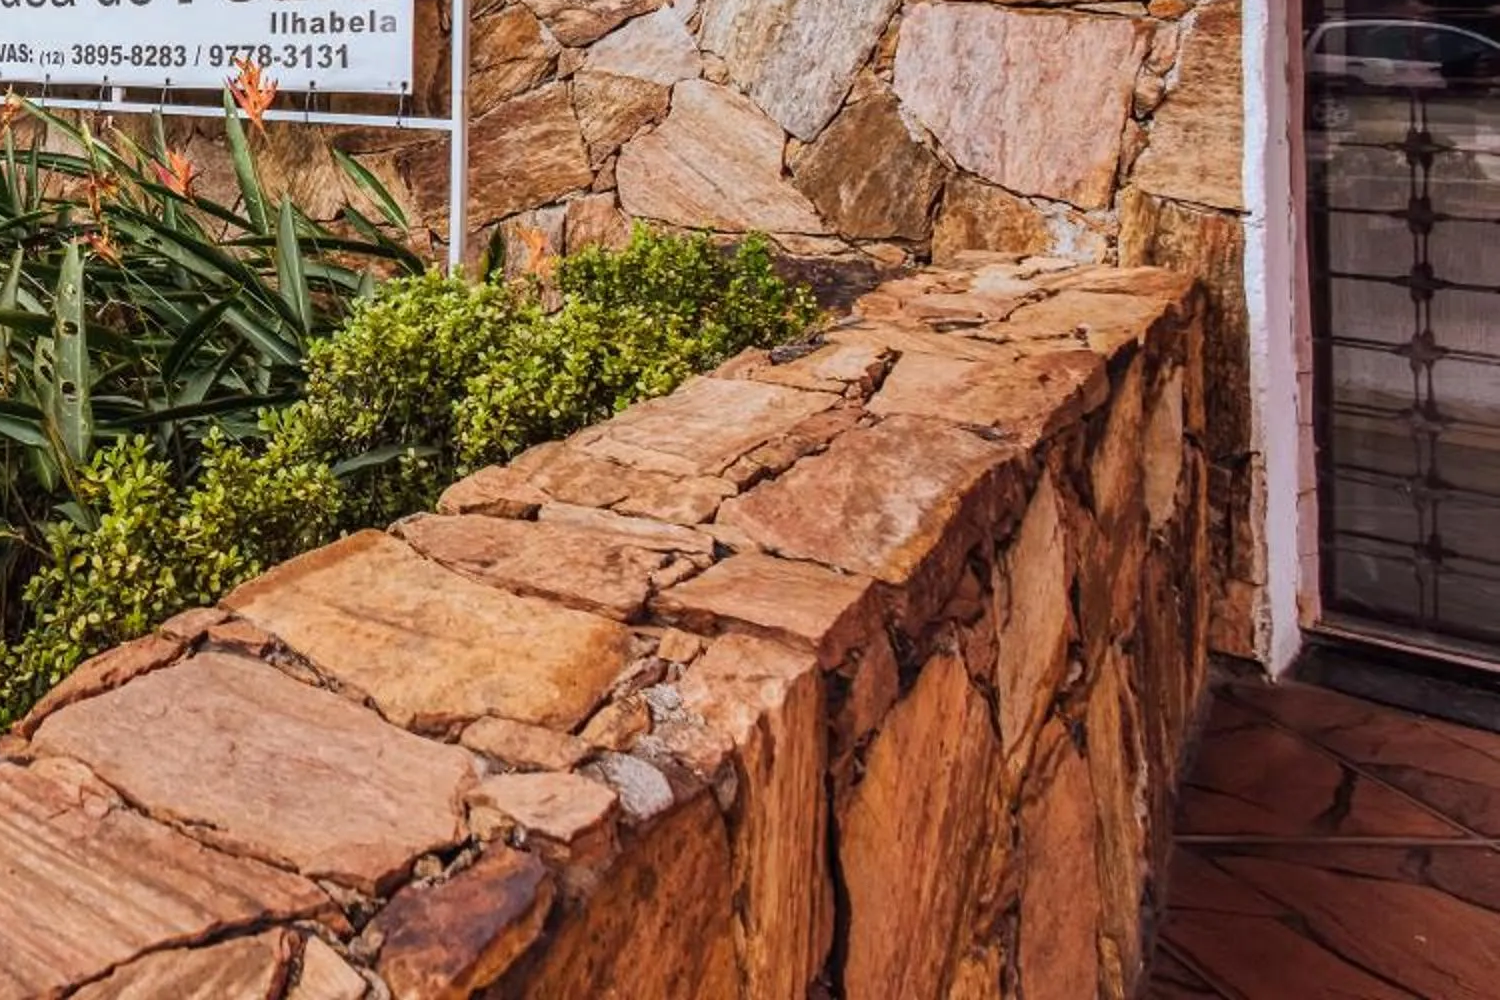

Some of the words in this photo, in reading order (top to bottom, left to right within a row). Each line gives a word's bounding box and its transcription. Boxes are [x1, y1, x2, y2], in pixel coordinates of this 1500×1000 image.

[270, 10, 398, 35] Ilhabela
[39, 50, 66, 67] (12)
[71, 44, 188, 68] 3895-8283
[194, 45, 202, 67] /
[208, 44, 350, 69] 9778-3131
